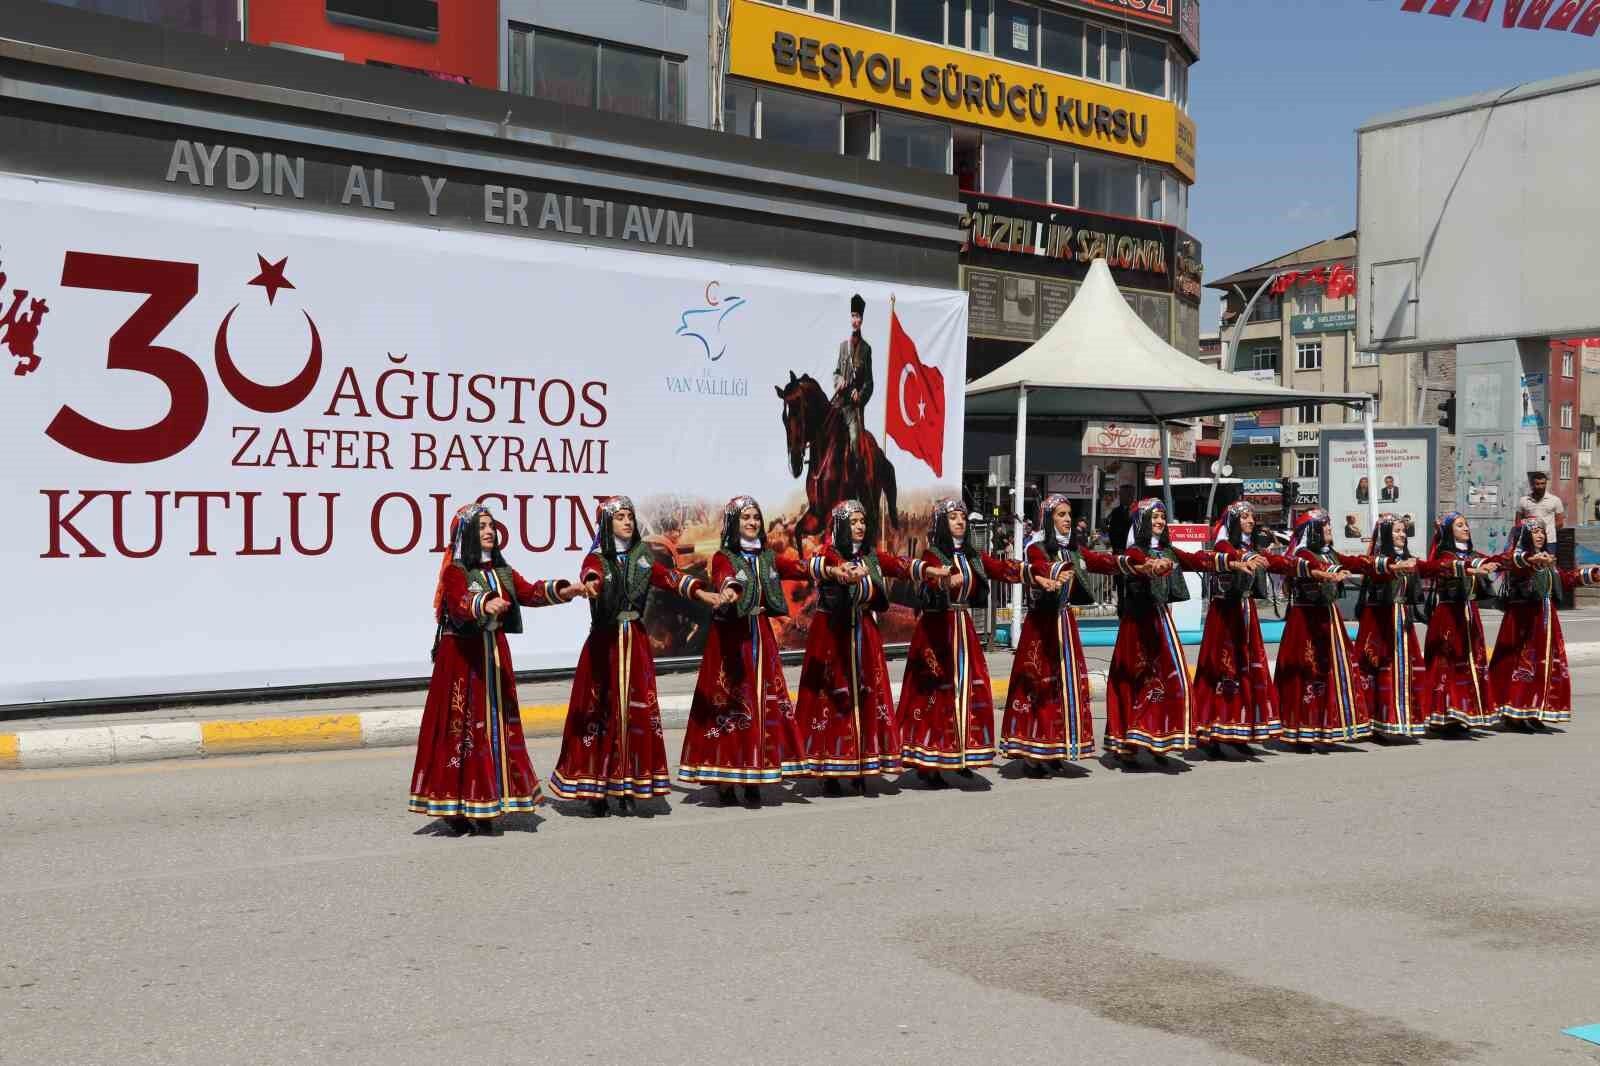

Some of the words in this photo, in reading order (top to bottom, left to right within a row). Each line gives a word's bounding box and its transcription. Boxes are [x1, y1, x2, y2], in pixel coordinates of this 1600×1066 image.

[772, 31, 911, 98] BEŞYOL
[920, 63, 1048, 122] SÜRÜCÜ
[1056, 95, 1148, 147] KURSU
[165, 139, 304, 199] AYDIN
[341, 165, 395, 210] AL
[537, 193, 614, 238] ALTI
[622, 205, 694, 248] AVM
[323, 352, 607, 428] AĞUSTOS
[665, 377, 691, 393] VAN
[232, 426, 394, 470] ZAFER
[411, 432, 609, 474] BAYRAMI
[40, 489, 340, 558] KUTLU
